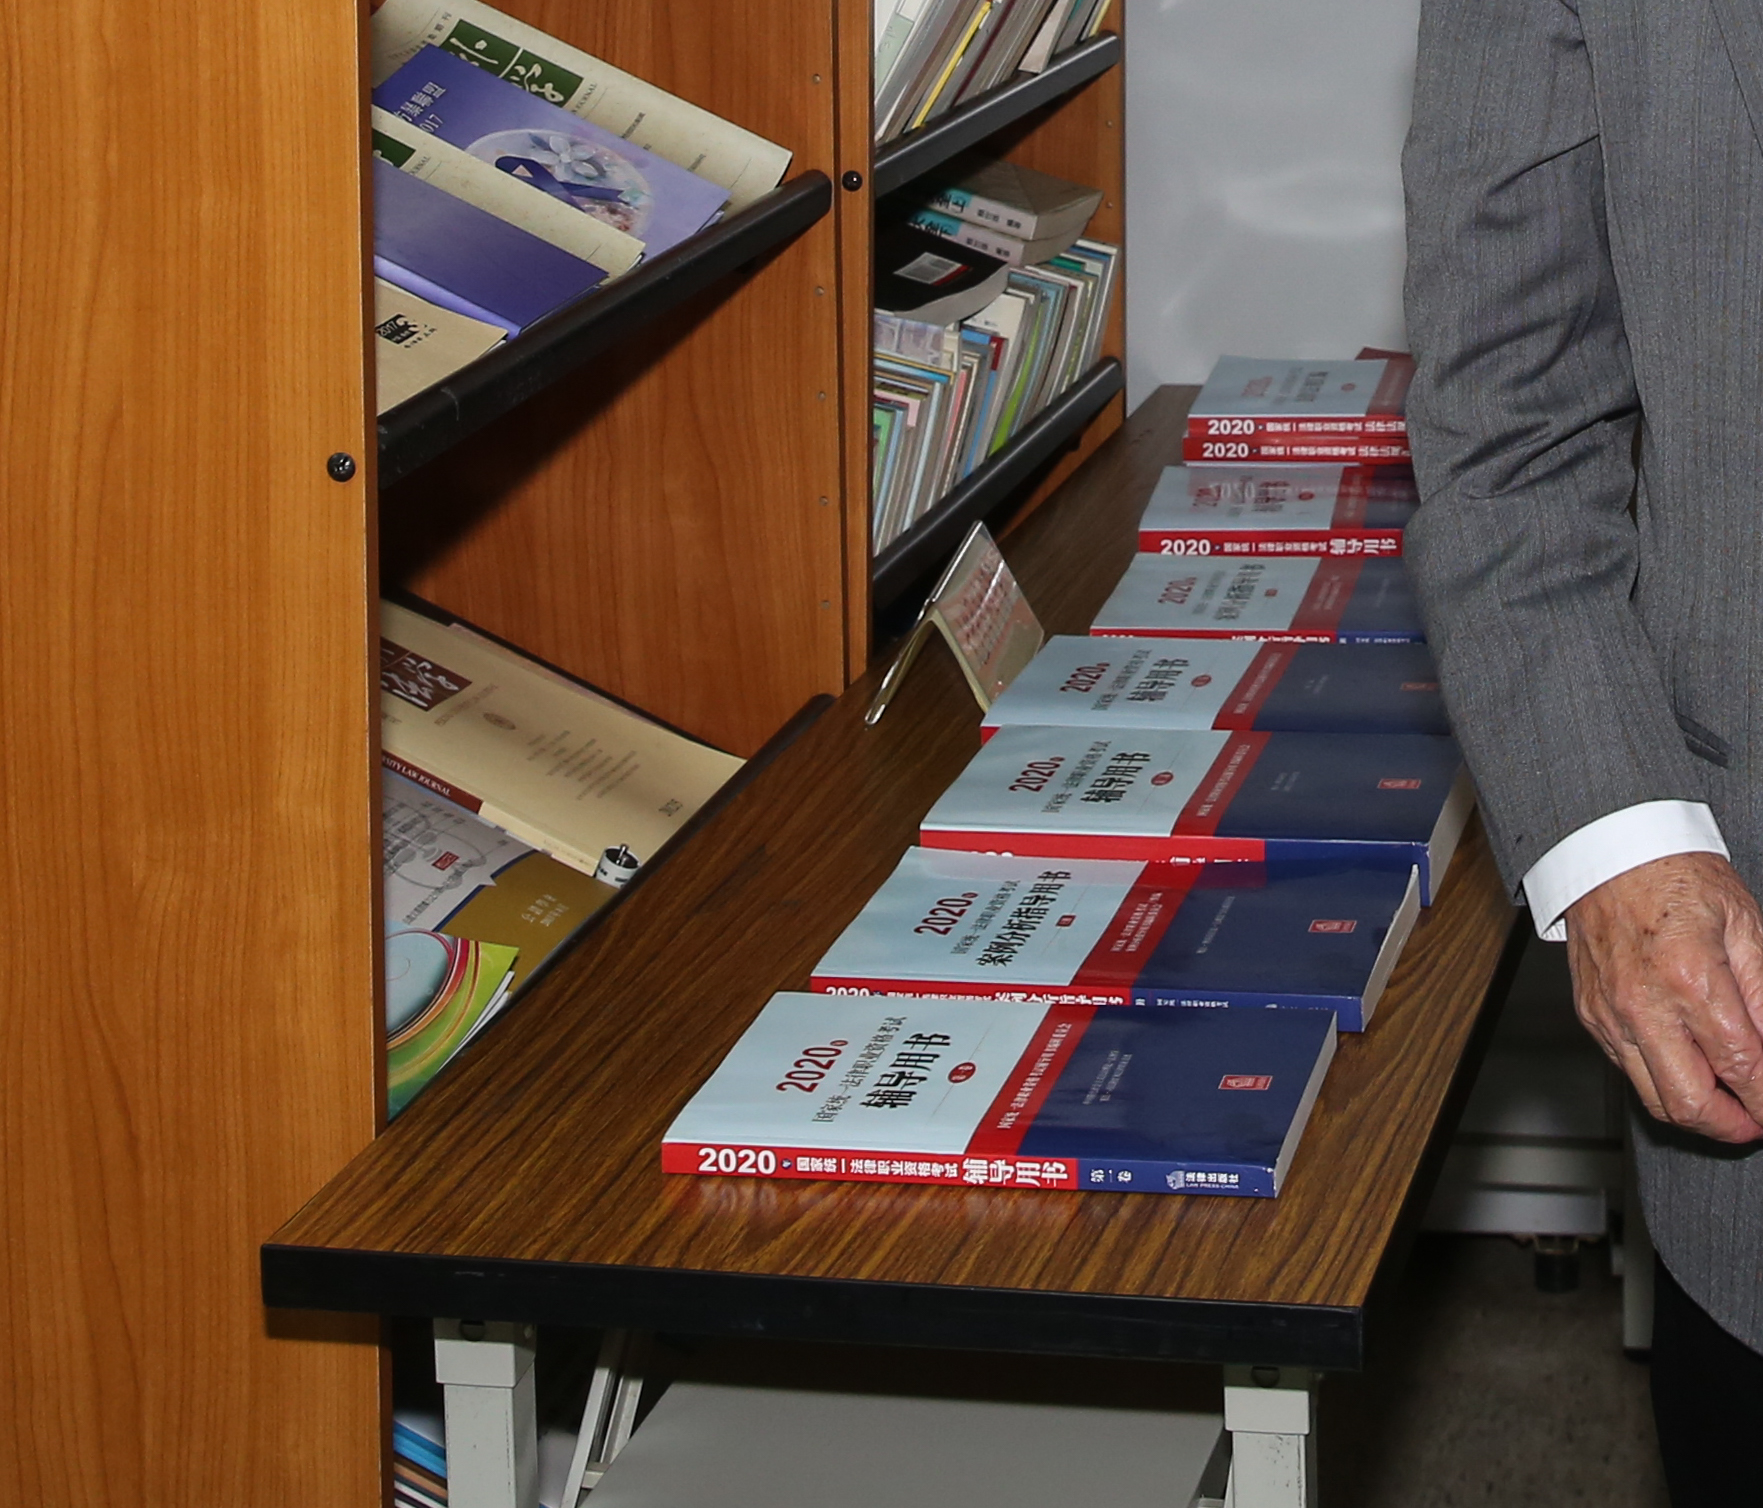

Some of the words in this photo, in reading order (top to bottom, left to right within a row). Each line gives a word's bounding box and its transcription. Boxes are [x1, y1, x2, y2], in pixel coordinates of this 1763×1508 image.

[419, 114, 444, 133] 017
[1208, 420, 1255, 435] 2020
[1203, 442, 1249, 458] 2020
[1160, 539, 1211, 555] 2020
[1060, 664, 1103, 693] 2020
[1009, 761, 1060, 793] 2020
[1080, 752, 1151, 803] 辅导用书
[914, 898, 973, 936] 2020
[975, 870, 1072, 967] 案例分析指导用书
[776, 1047, 842, 1093] 2020
[859, 1033, 951, 1108] 辅导用书
[699, 1147, 777, 1174] 2020
[796, 1156, 958, 1179] 国家统一法律职业资格考试
[962, 1158, 1068, 1187] 辅导用书
[1186, 1172, 1239, 1183] 法律出版社
